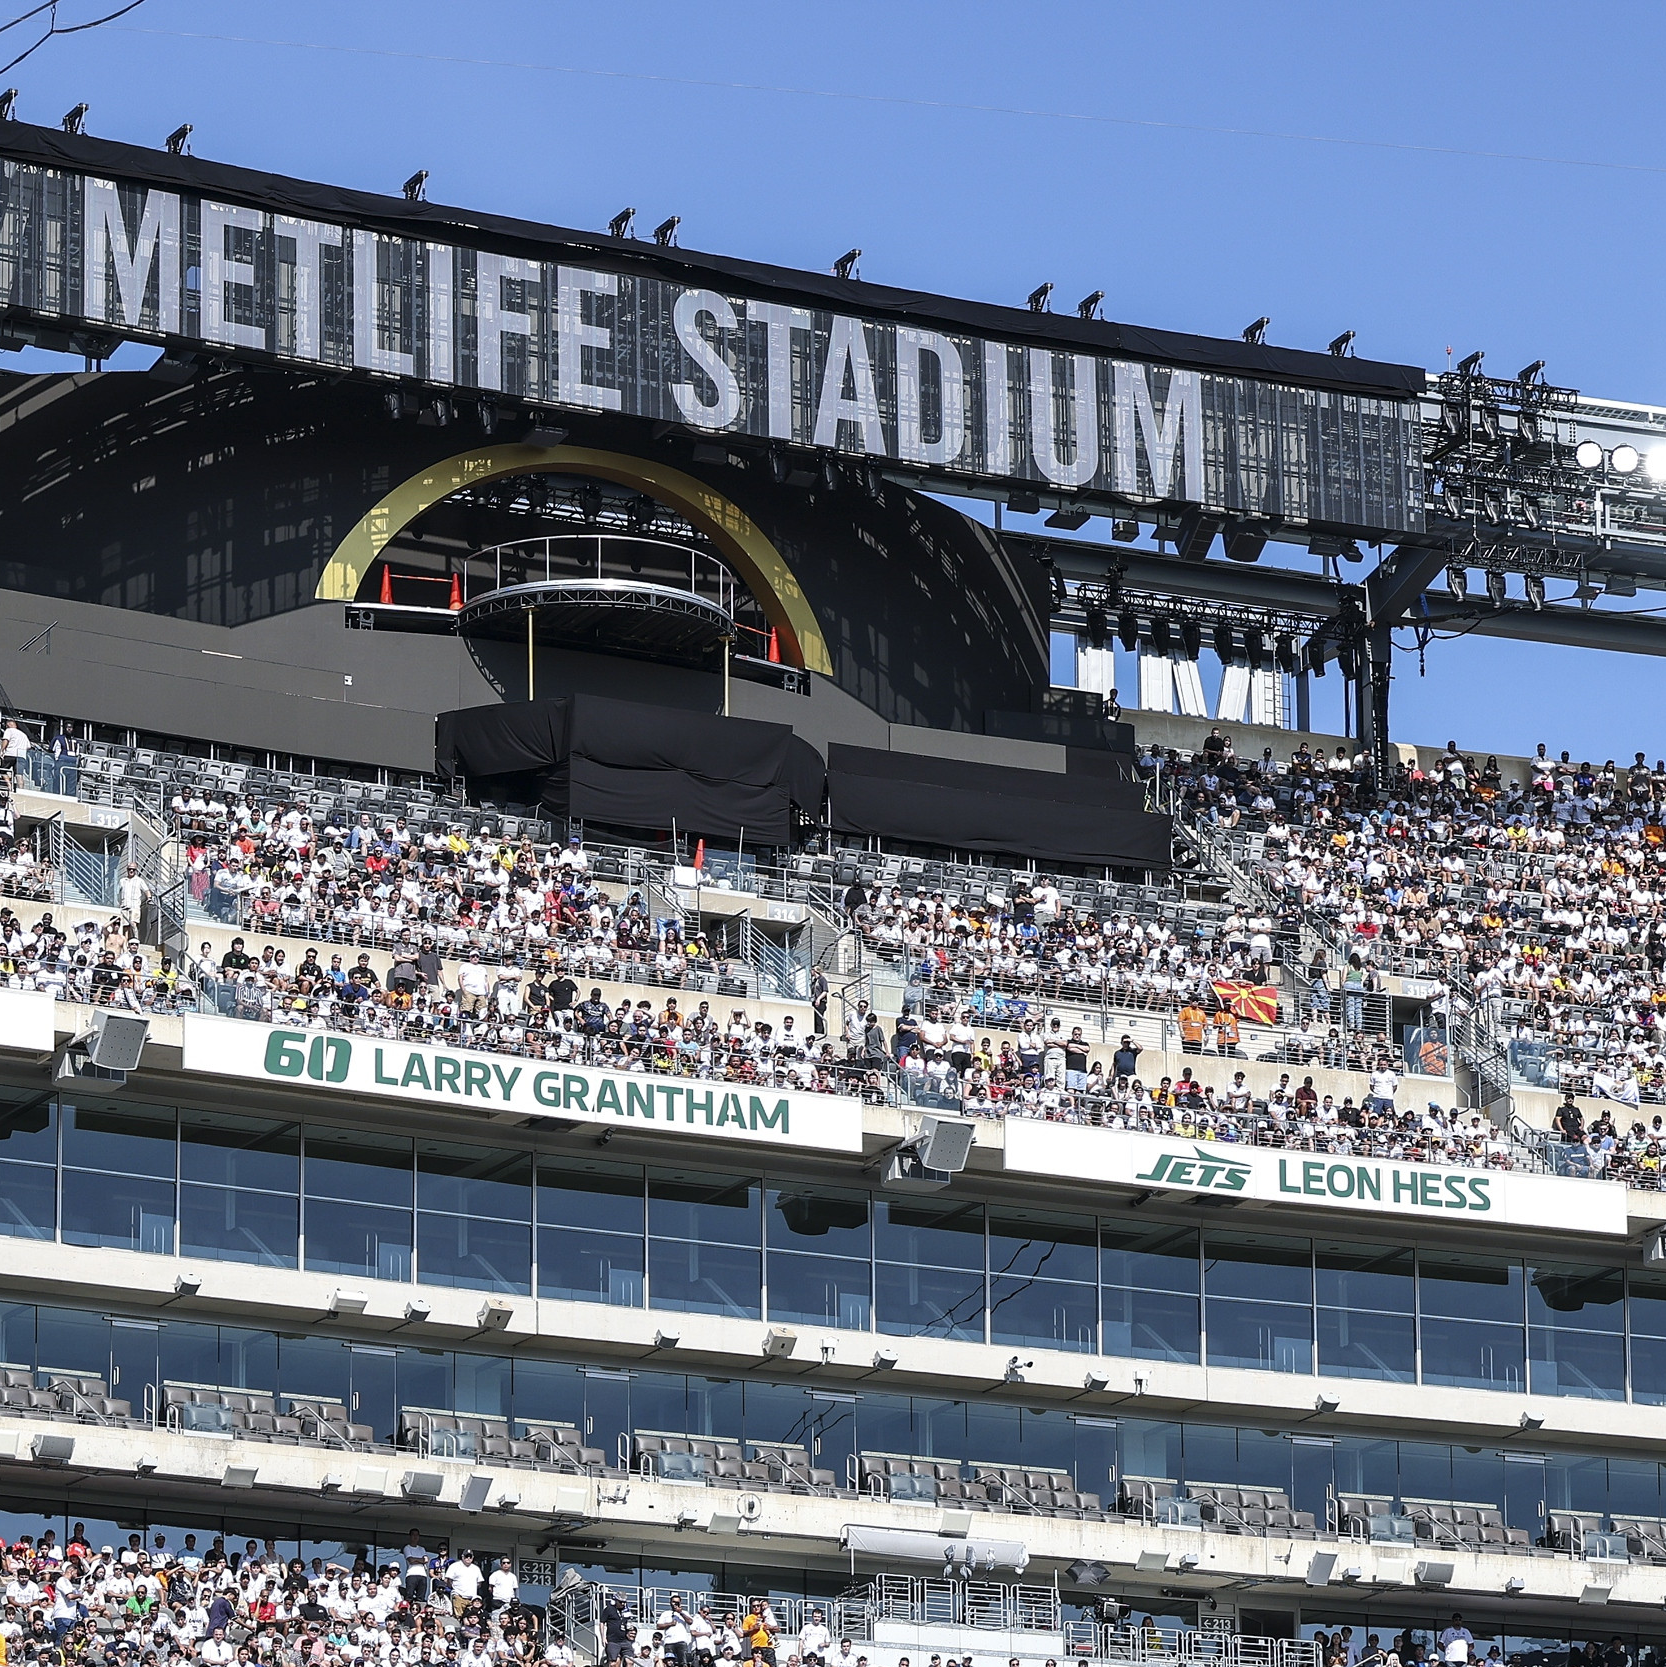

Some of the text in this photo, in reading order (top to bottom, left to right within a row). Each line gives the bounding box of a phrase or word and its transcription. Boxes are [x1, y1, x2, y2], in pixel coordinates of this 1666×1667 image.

[86, 176, 1203, 504] METLIFE STADIUM
[97, 813, 119, 829] 313
[264, 1030, 789, 1134] 60 LARRY GRANTHAM
[1136, 1146, 1490, 1211] JETS LEON HESS
[533, 1562, 552, 1572] 212
[532, 1574, 551, 1586] 213
[1213, 1619, 1231, 1630] 213
